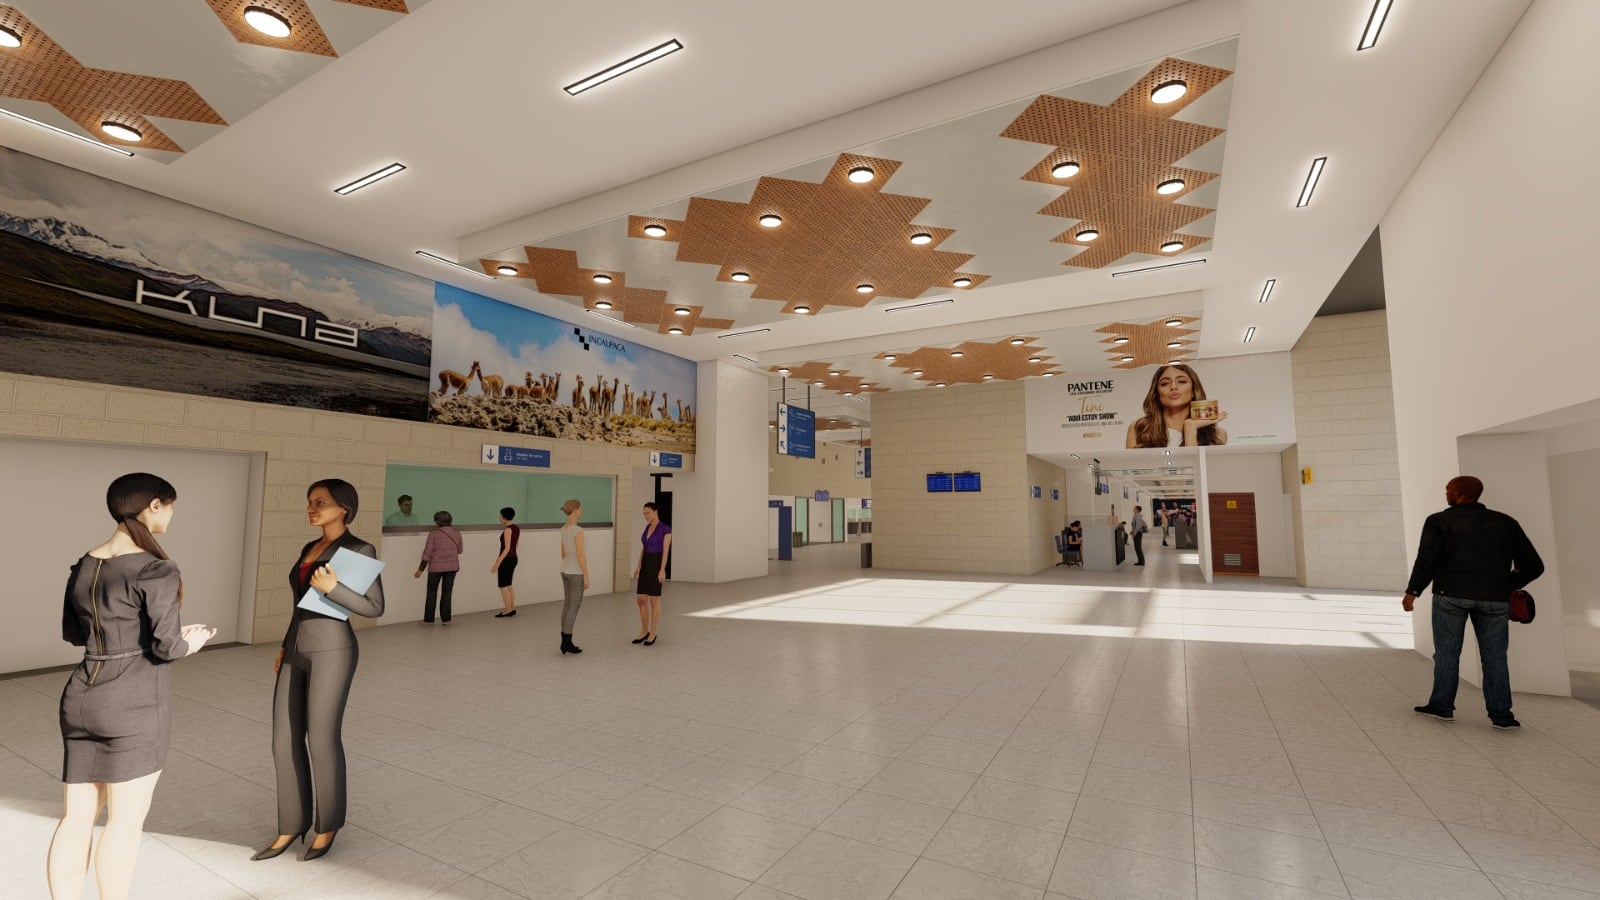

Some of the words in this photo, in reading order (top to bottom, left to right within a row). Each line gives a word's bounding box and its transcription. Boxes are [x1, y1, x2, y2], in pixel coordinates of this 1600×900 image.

[588, 335, 626, 352] INCALPACA
[1067, 380, 1114, 392] PANTENE
[1081, 413, 1098, 421] ESTOY
